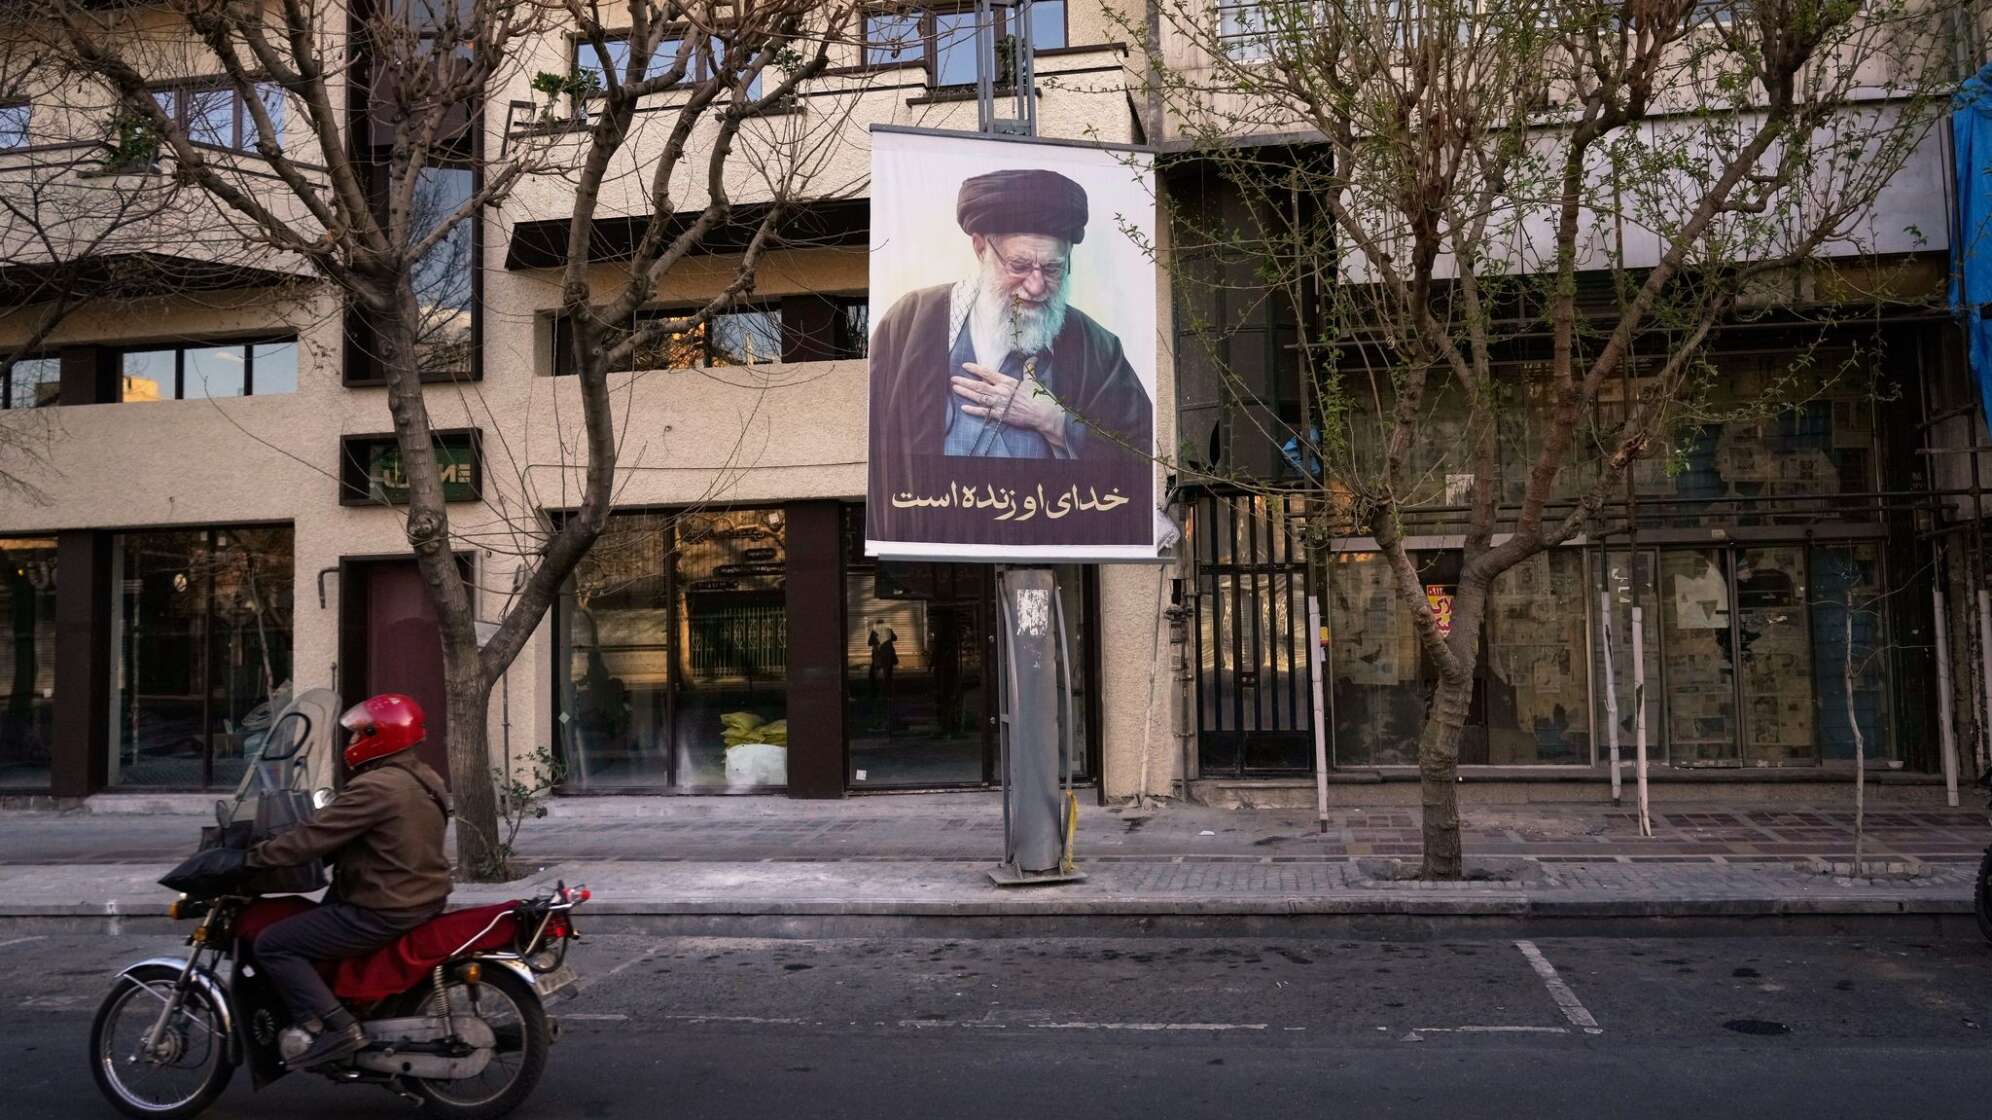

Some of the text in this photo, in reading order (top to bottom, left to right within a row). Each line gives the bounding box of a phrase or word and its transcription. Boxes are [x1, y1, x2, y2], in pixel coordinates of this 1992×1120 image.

[891, 480, 1129, 521] خدای او زنده است
